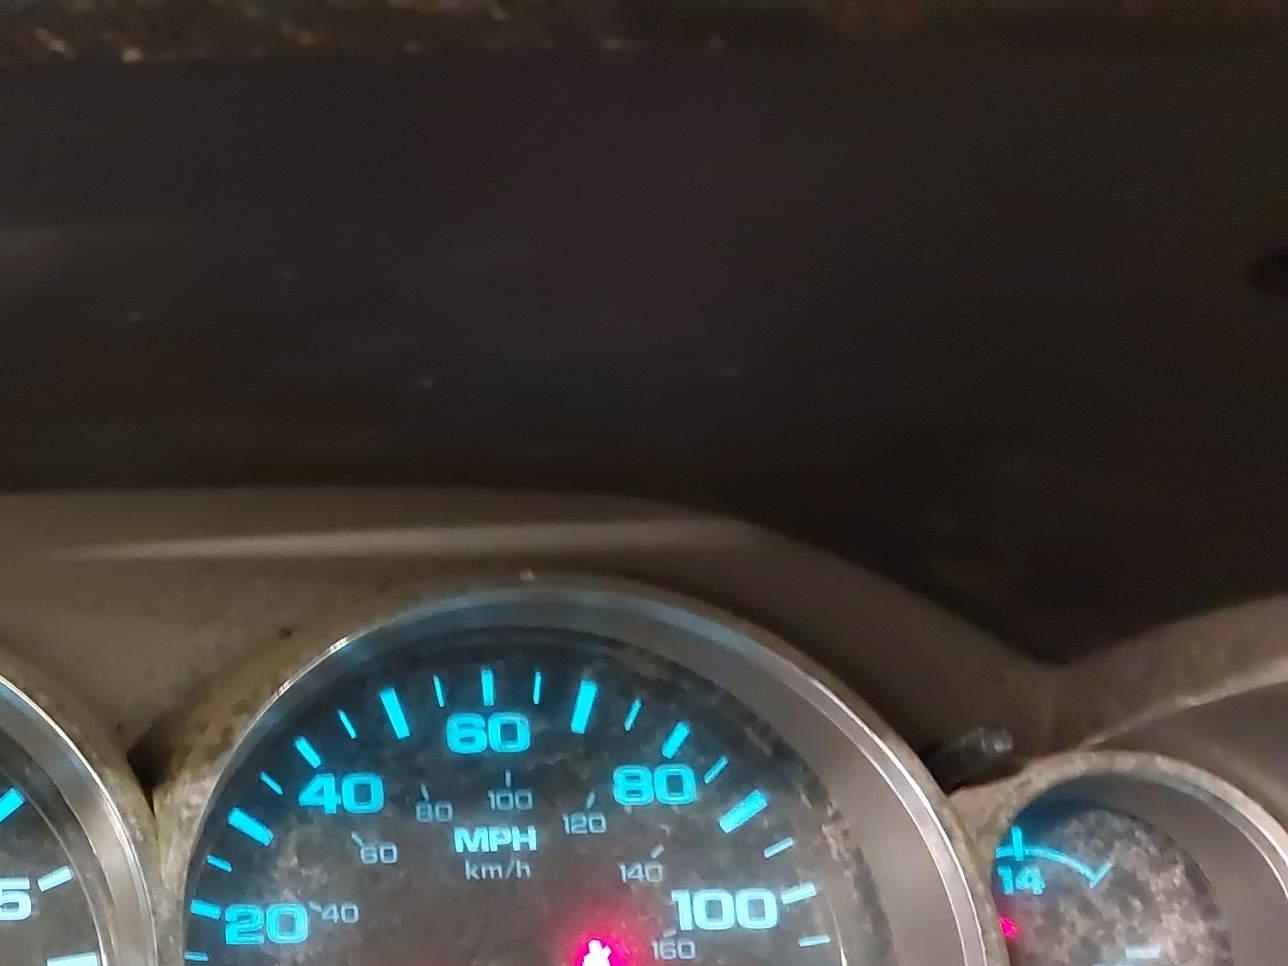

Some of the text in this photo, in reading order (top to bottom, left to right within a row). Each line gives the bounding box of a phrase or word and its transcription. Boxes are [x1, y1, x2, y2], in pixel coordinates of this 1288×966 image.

[446, 712, 531, 754] 60
[298, 773, 385, 815] 40
[612, 764, 698, 805] 80
[415, 801, 455, 823] 80
[487, 788, 533, 812] 100
[562, 812, 607, 835] 120
[453, 825, 538, 853] MPH
[359, 842, 399, 865] 60
[464, 860, 532, 880] km/h
[620, 861, 665, 883] 140
[998, 865, 1046, 895] 14
[321, 902, 360, 925] 40
[669, 888, 779, 931] 100
[223, 901, 308, 945] 20
[652, 937, 697, 961] 160
